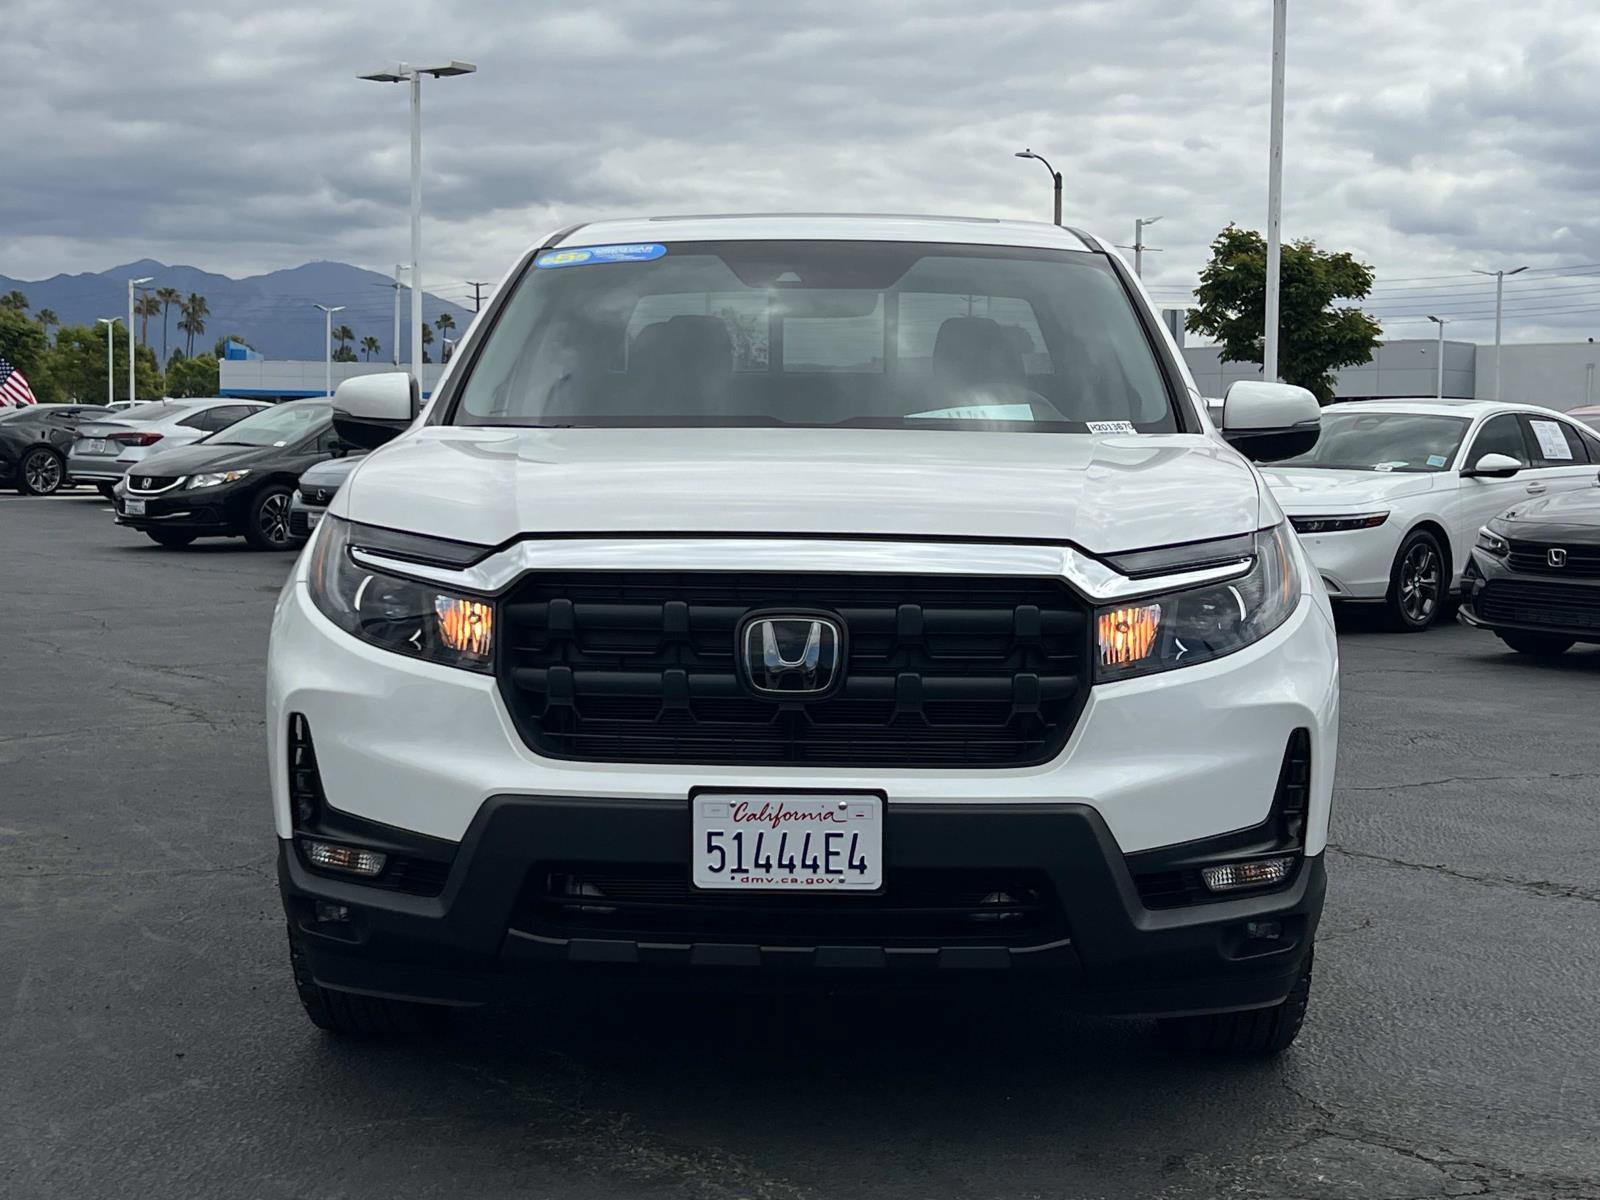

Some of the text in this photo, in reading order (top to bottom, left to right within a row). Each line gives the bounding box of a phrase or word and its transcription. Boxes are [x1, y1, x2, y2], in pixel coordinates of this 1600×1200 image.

[733, 801, 848, 829] California
[706, 831, 868, 875] 51444E4
[741, 876, 835, 885] dmv.ca.gov
